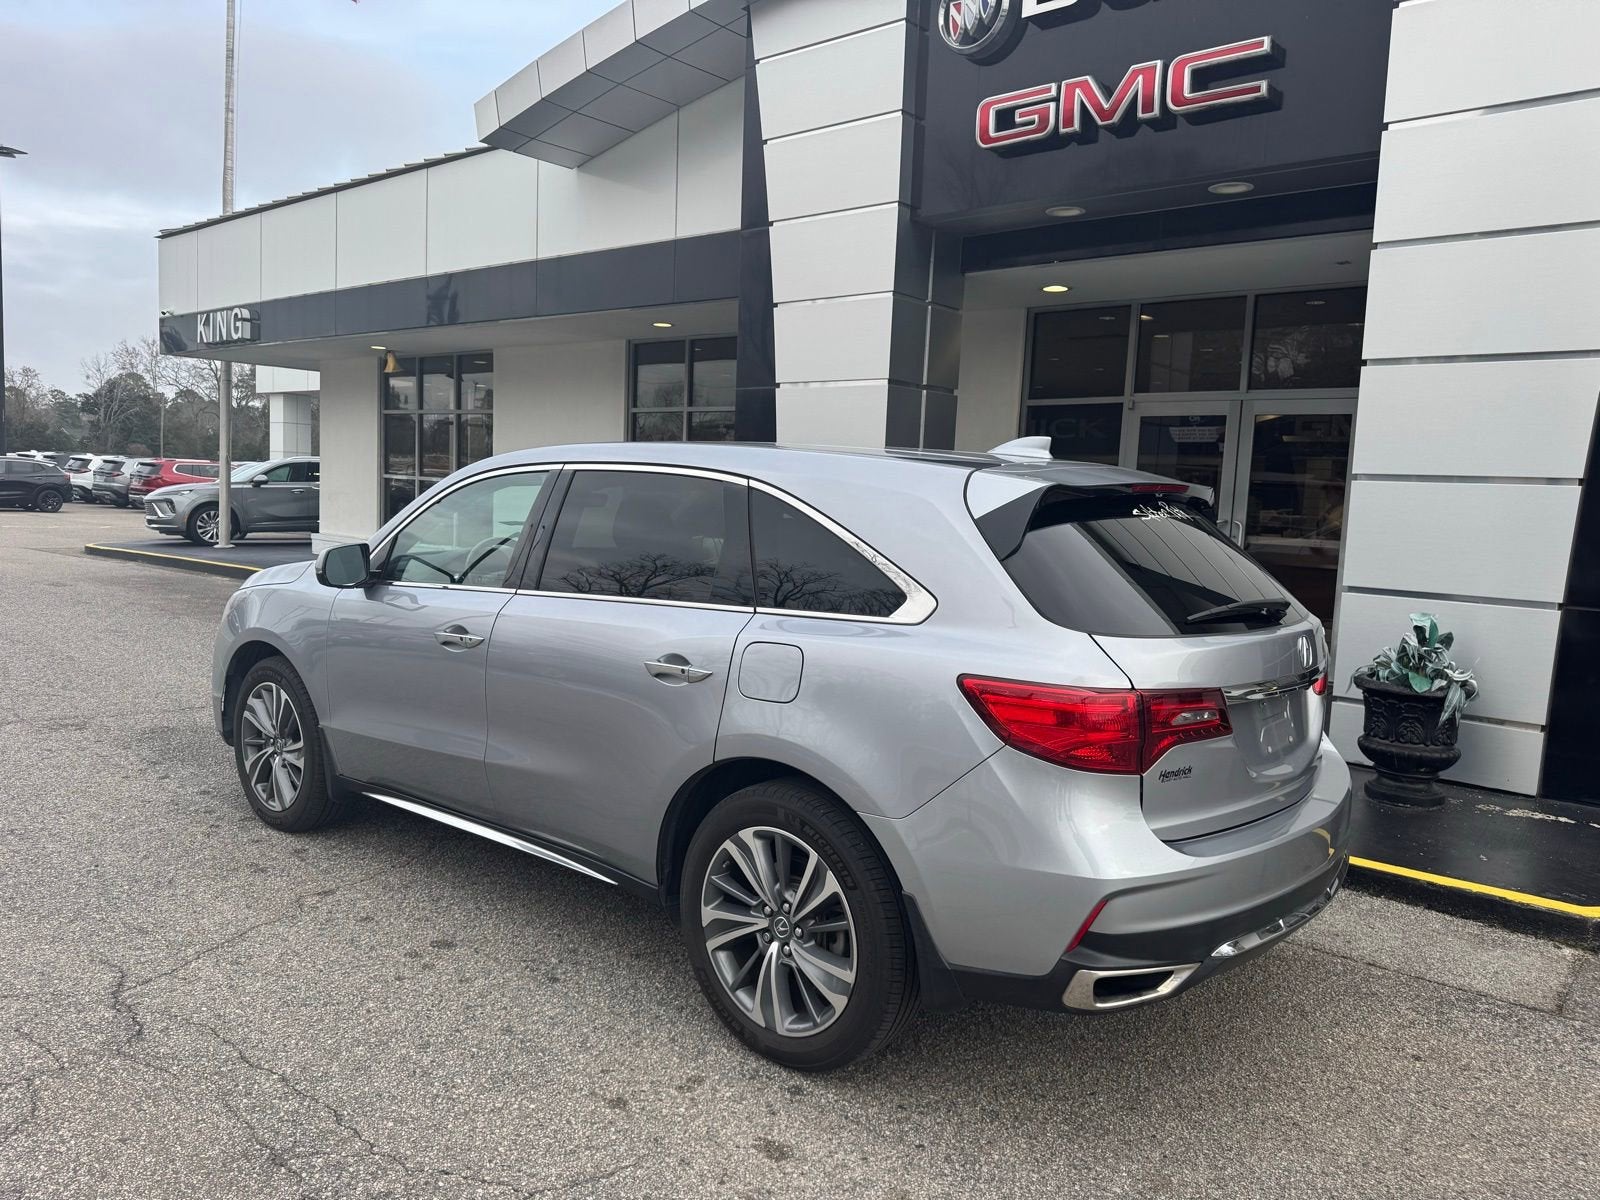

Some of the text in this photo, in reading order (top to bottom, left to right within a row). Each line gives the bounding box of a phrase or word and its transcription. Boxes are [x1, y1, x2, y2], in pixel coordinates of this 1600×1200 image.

[975, 34, 1273, 150] GMC
[197, 307, 250, 343] KING
[1158, 765, 1193, 783] Hendrick
[802, 824, 856, 889] MICHELIN
